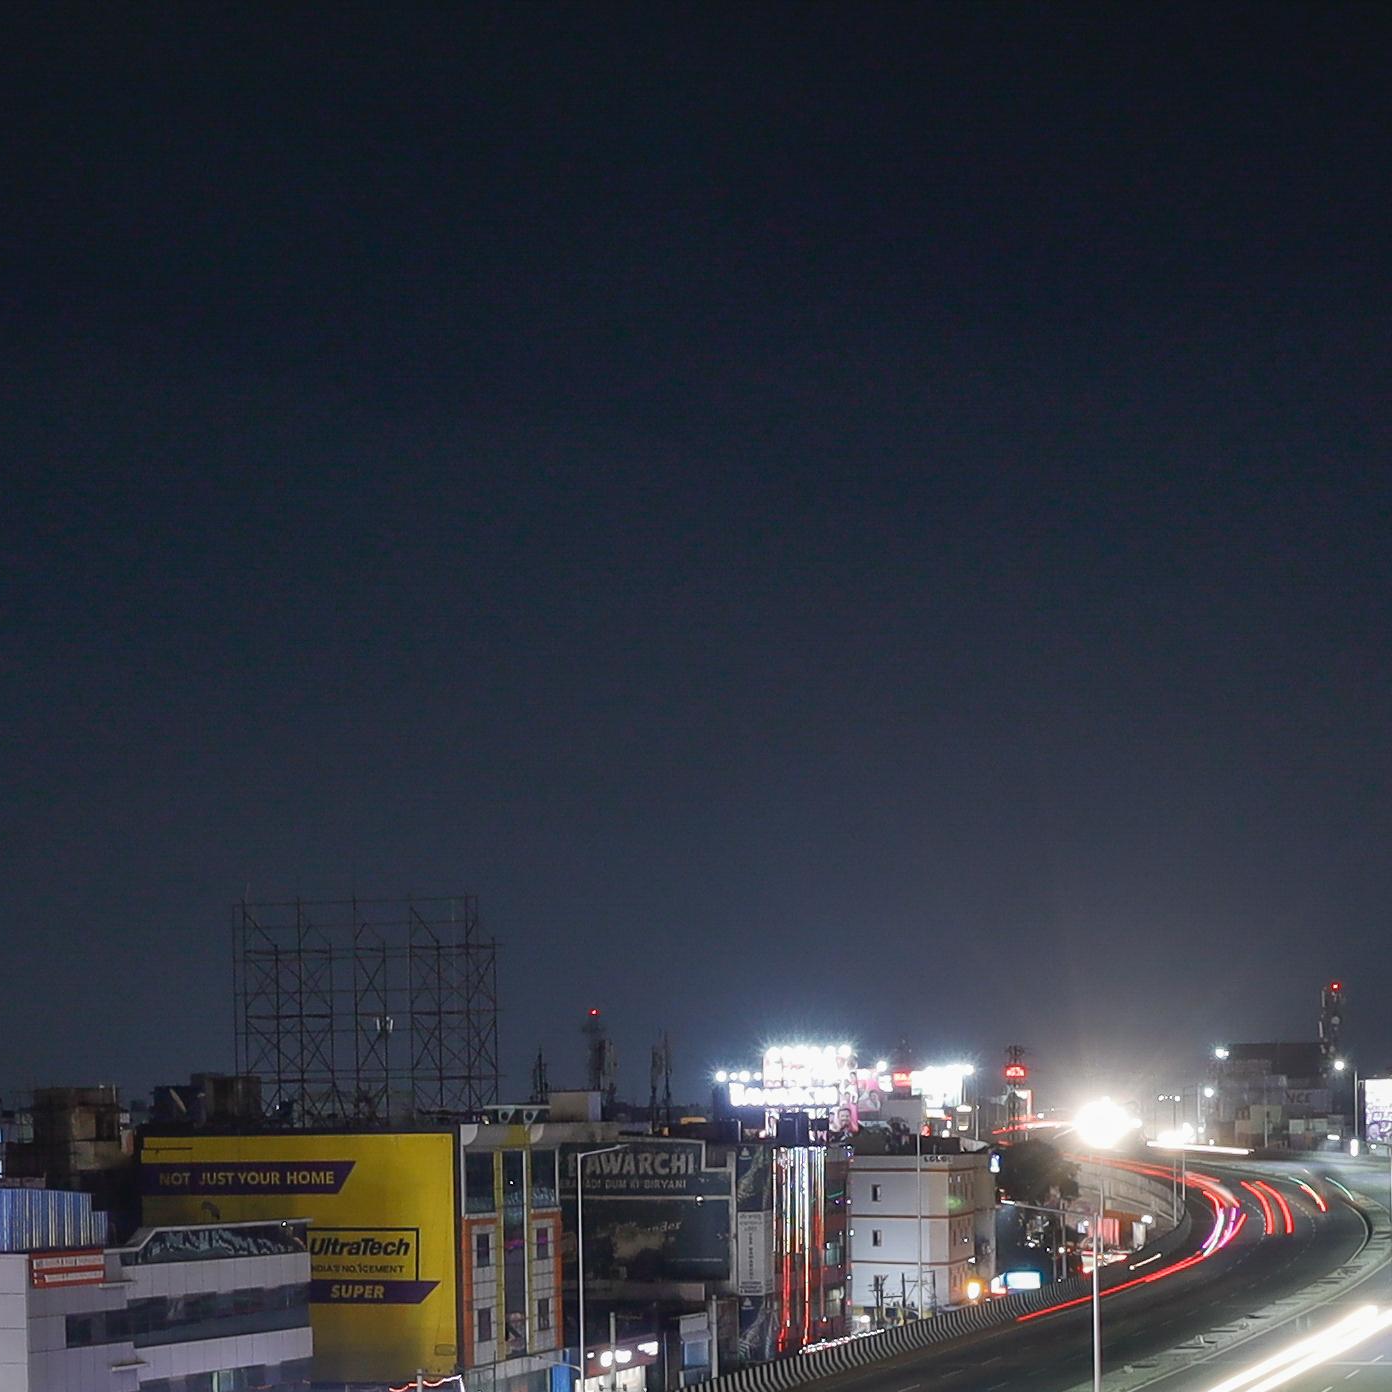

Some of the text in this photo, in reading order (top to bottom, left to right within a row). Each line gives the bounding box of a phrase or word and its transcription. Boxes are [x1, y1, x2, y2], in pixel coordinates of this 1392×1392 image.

[159, 1171, 335, 1186] NOT JUST YOUR HOME
[309, 1237, 411, 1256] UltraTech
[330, 1284, 386, 1299] SUPER
